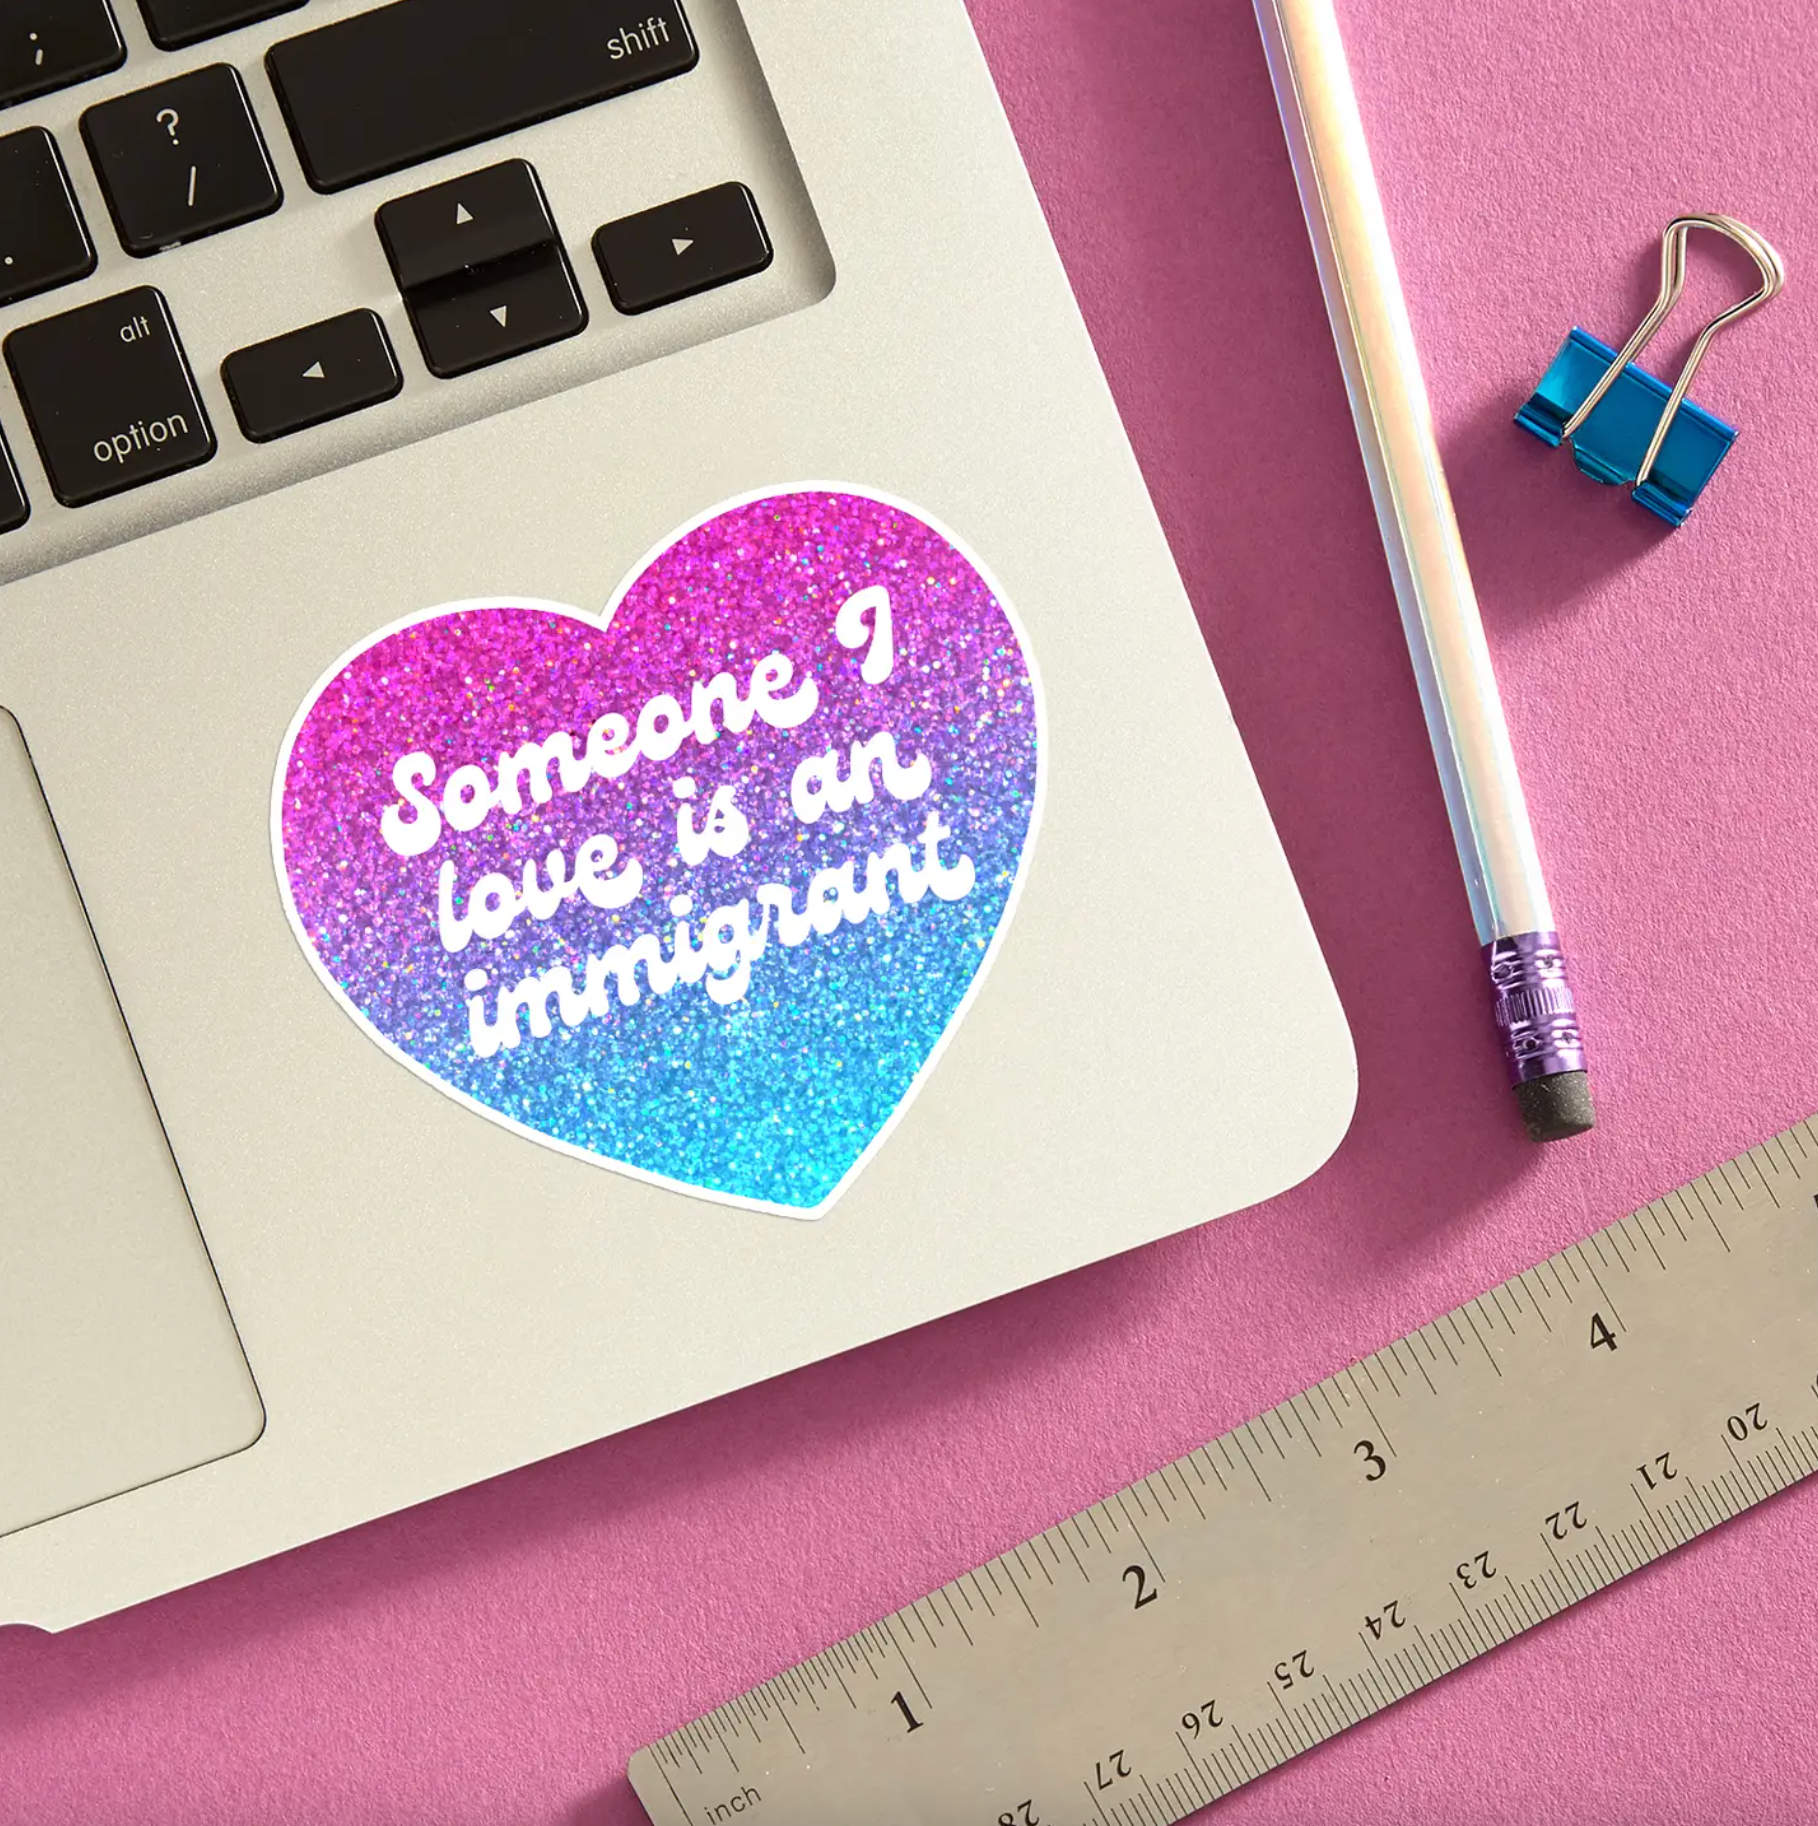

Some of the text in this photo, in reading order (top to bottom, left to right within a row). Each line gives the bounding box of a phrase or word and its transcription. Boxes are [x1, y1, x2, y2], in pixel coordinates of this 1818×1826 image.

[607, 17, 670, 60] shift
[156, 108, 179, 145] ?
[120, 316, 150, 343] alt
[93, 414, 188, 464] option
[381, 586, 894, 857] Someone I
[437, 731, 932, 953] love is an
[464, 811, 976, 1058] immigrant
[1727, 1402, 1768, 1441] 20
[1636, 1451, 1678, 1490] 21
[890, 1312, 1618, 1734] 1 2 3 4
[1545, 1501, 1588, 1540] 22
[1456, 1550, 1497, 1590] 23
[1364, 1600, 1406, 1641] 24
[1273, 1649, 1315, 1690] 25
[1181, 1699, 1223, 1740] 26
[1095, 1749, 1132, 1791] 27
[705, 1784, 762, 1825] inch
